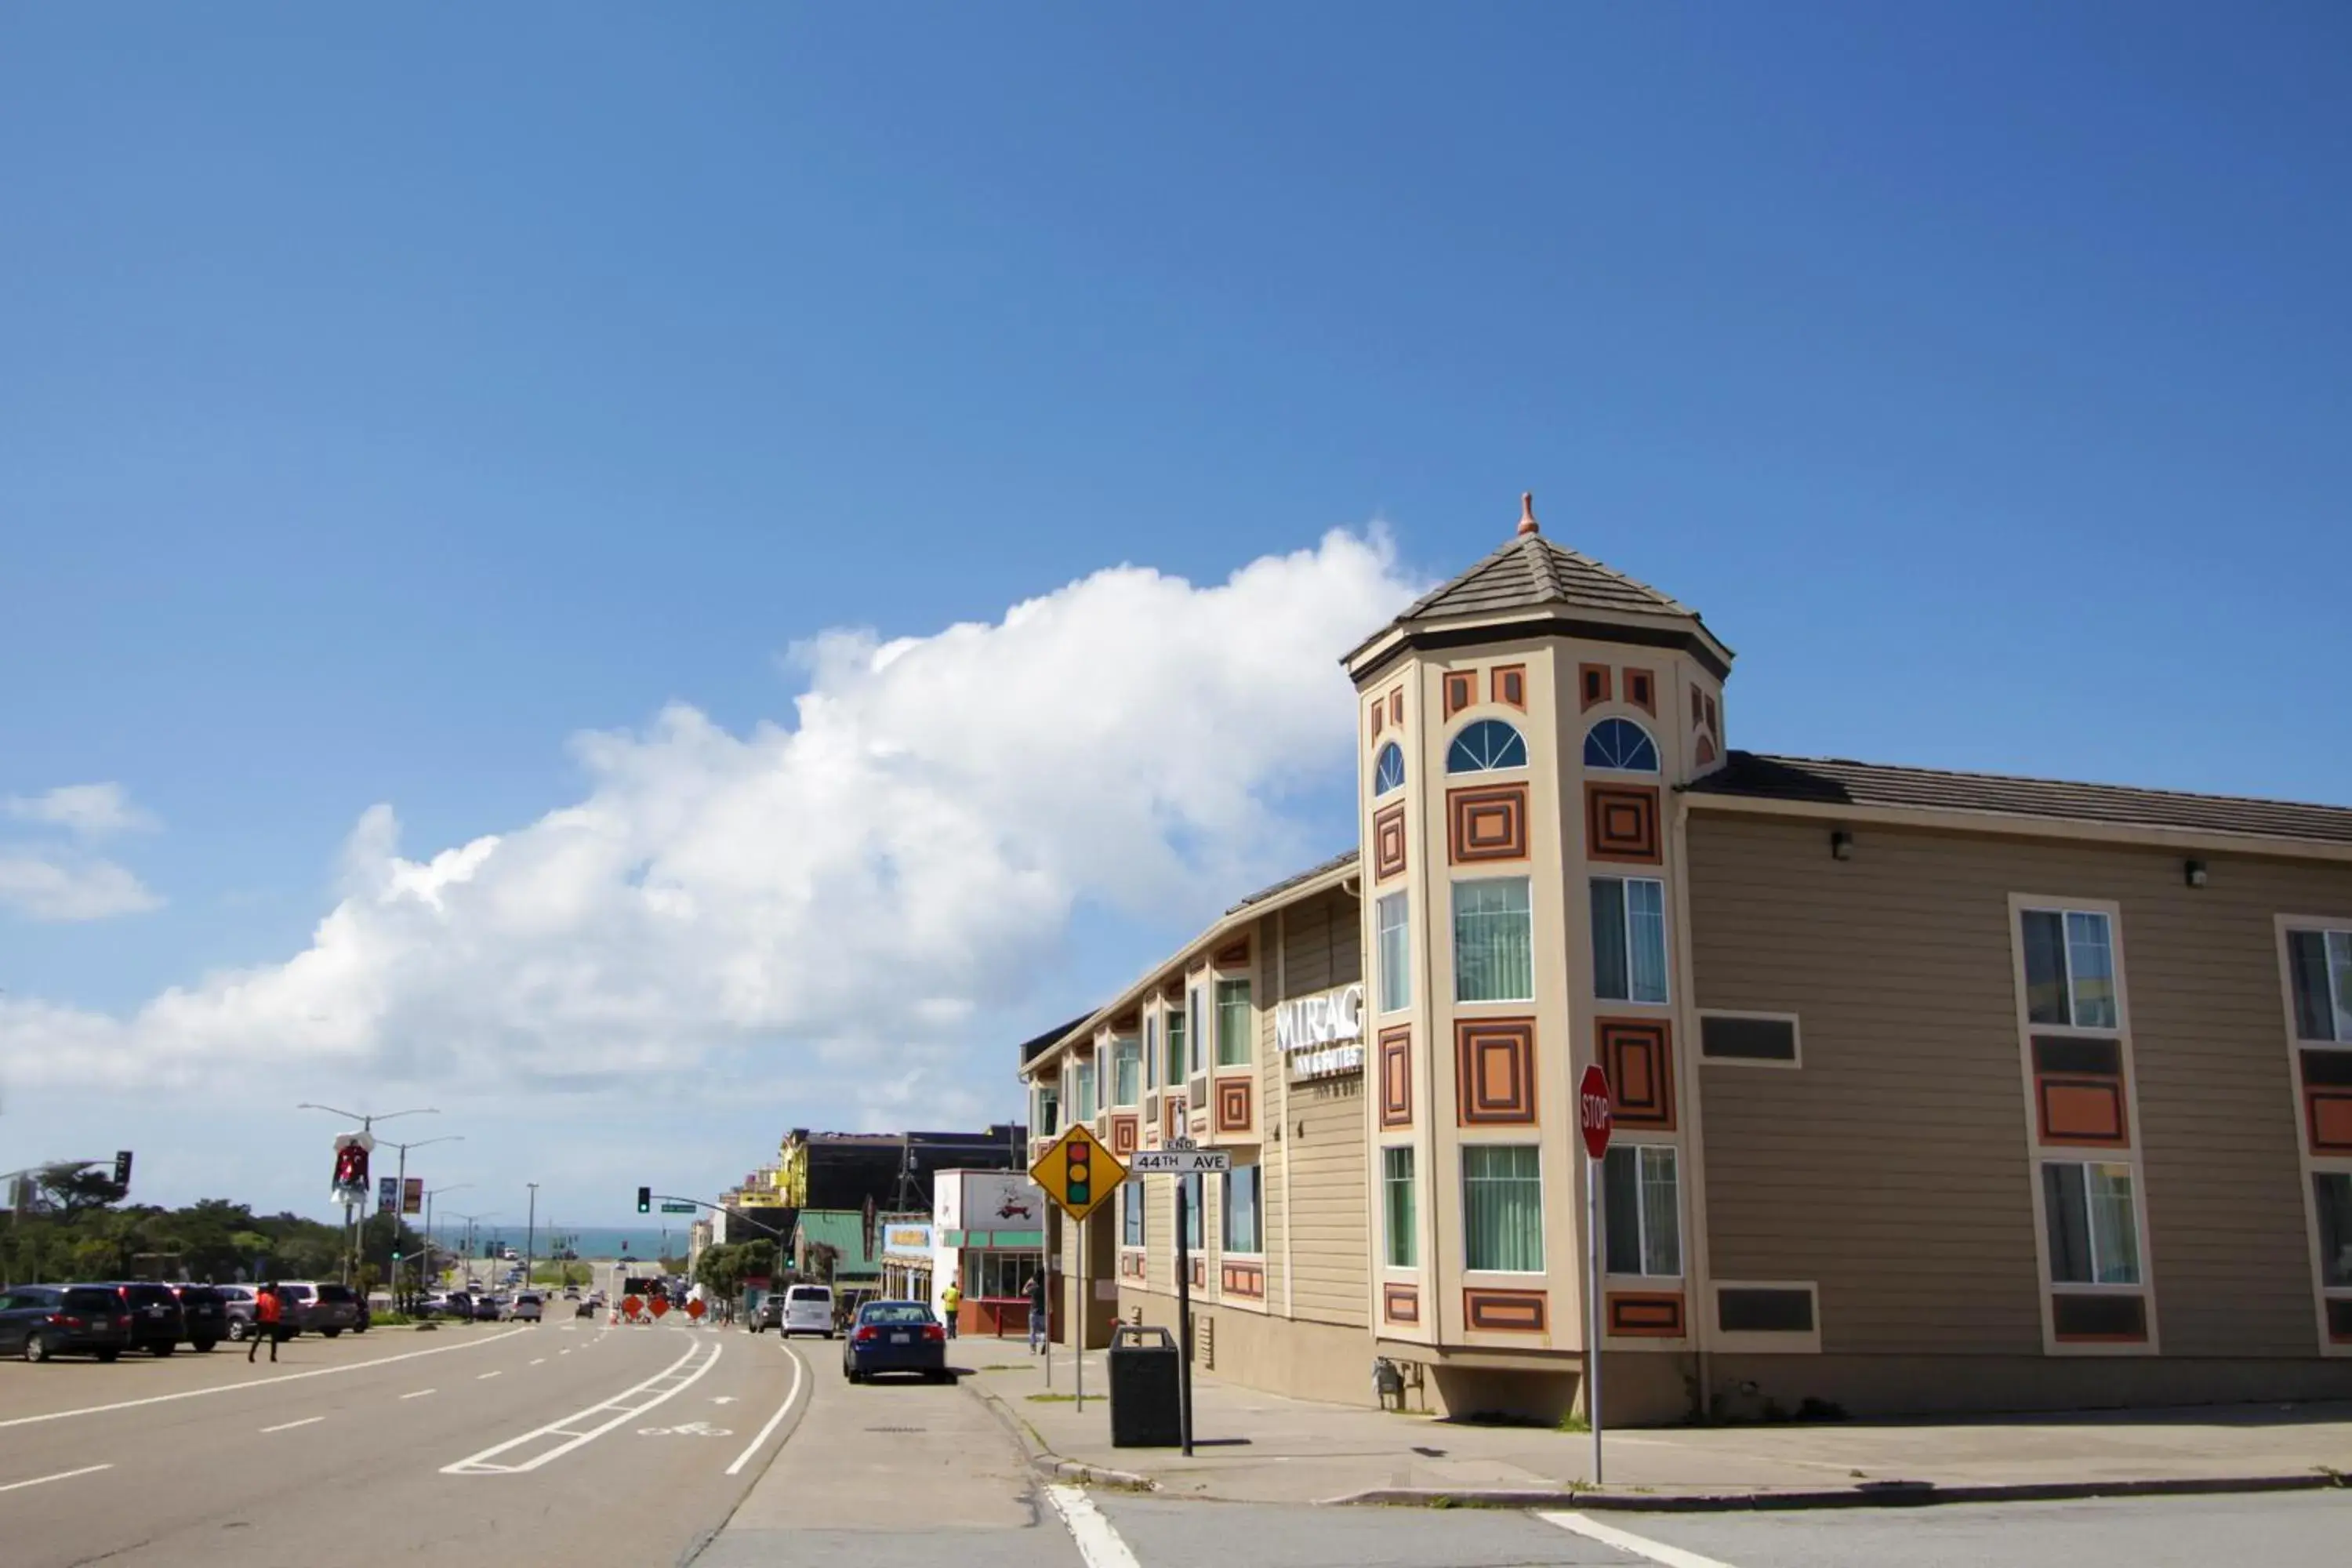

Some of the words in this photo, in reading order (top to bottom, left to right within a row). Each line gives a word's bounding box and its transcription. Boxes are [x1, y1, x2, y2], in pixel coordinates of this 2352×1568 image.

[1583, 1093, 1608, 1130] STOP
[1167, 1141, 1192, 1149] END
[1138, 1156, 1179, 1168] 44TH
[1192, 1156, 1225, 1168] AVE
